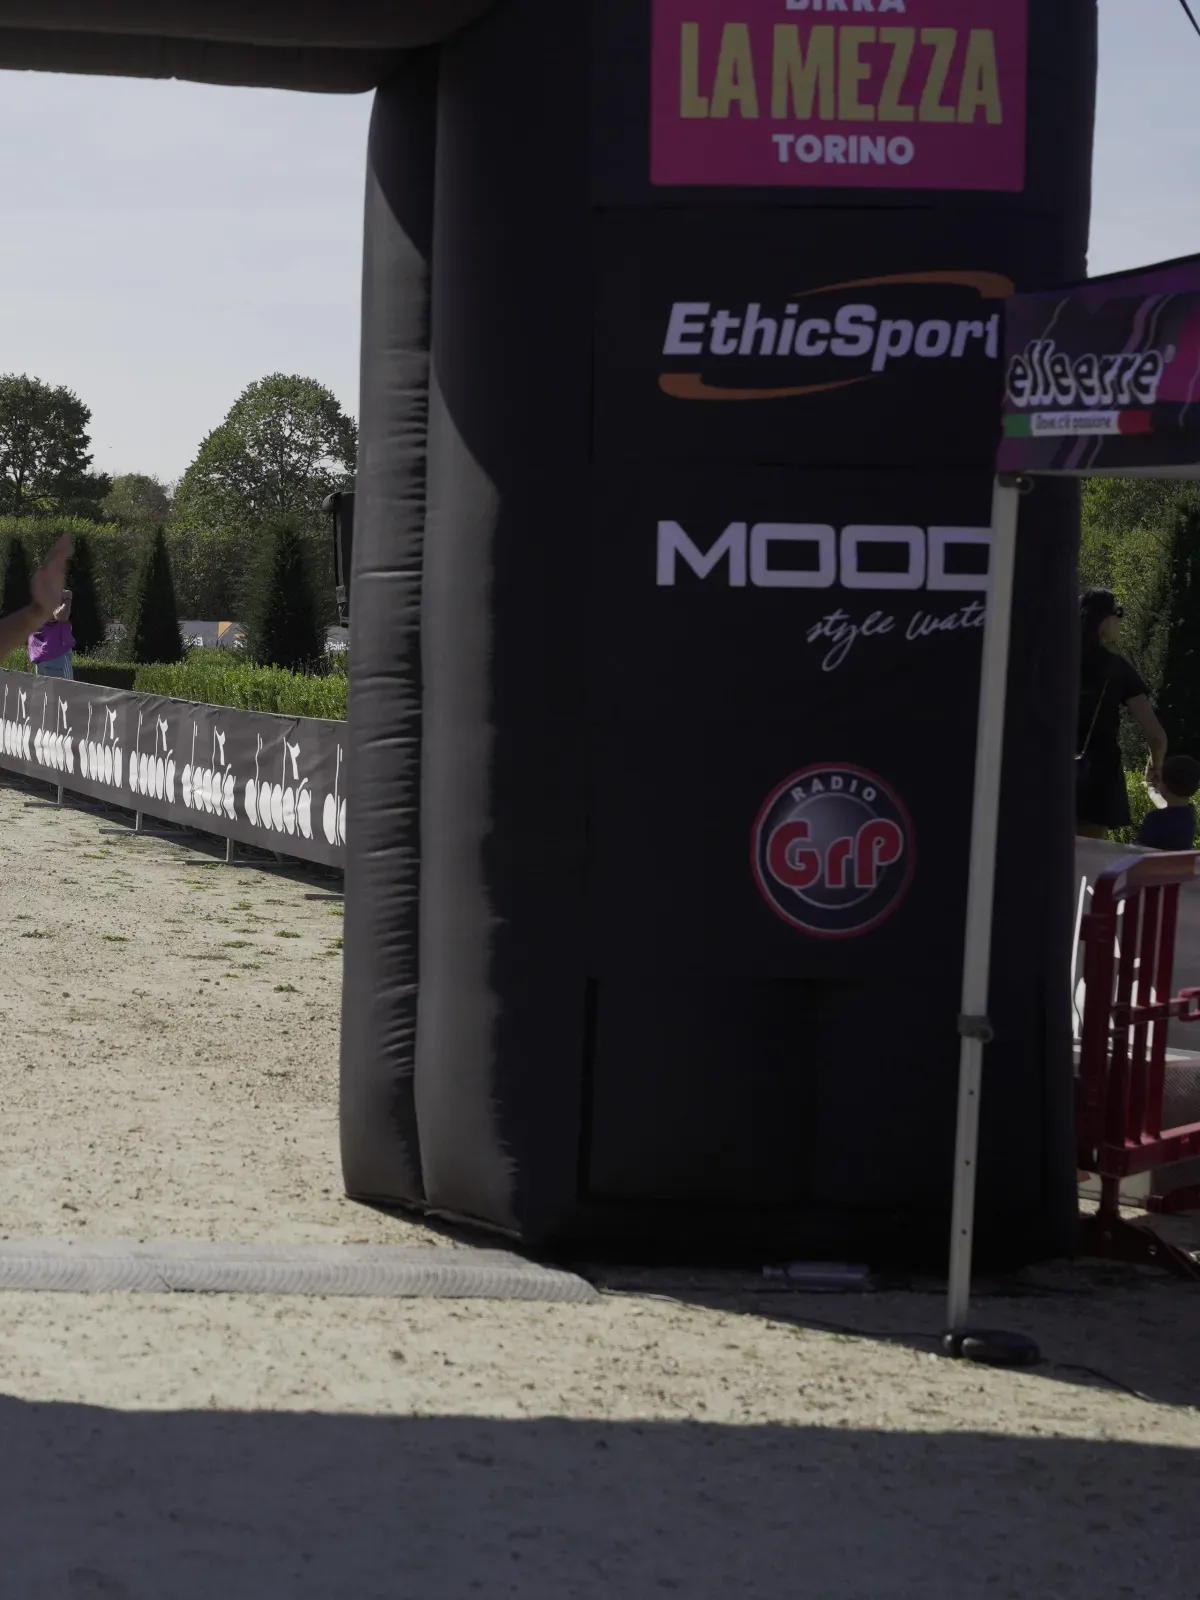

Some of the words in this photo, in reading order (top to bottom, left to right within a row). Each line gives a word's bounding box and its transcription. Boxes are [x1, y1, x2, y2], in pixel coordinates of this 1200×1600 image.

[680, 22, 759, 118] LA
[771, 24, 1003, 125] MEZZA
[772, 133, 915, 165] TORINO
[806, 608, 896, 672] style
[790, 775, 877, 801] RADIO
